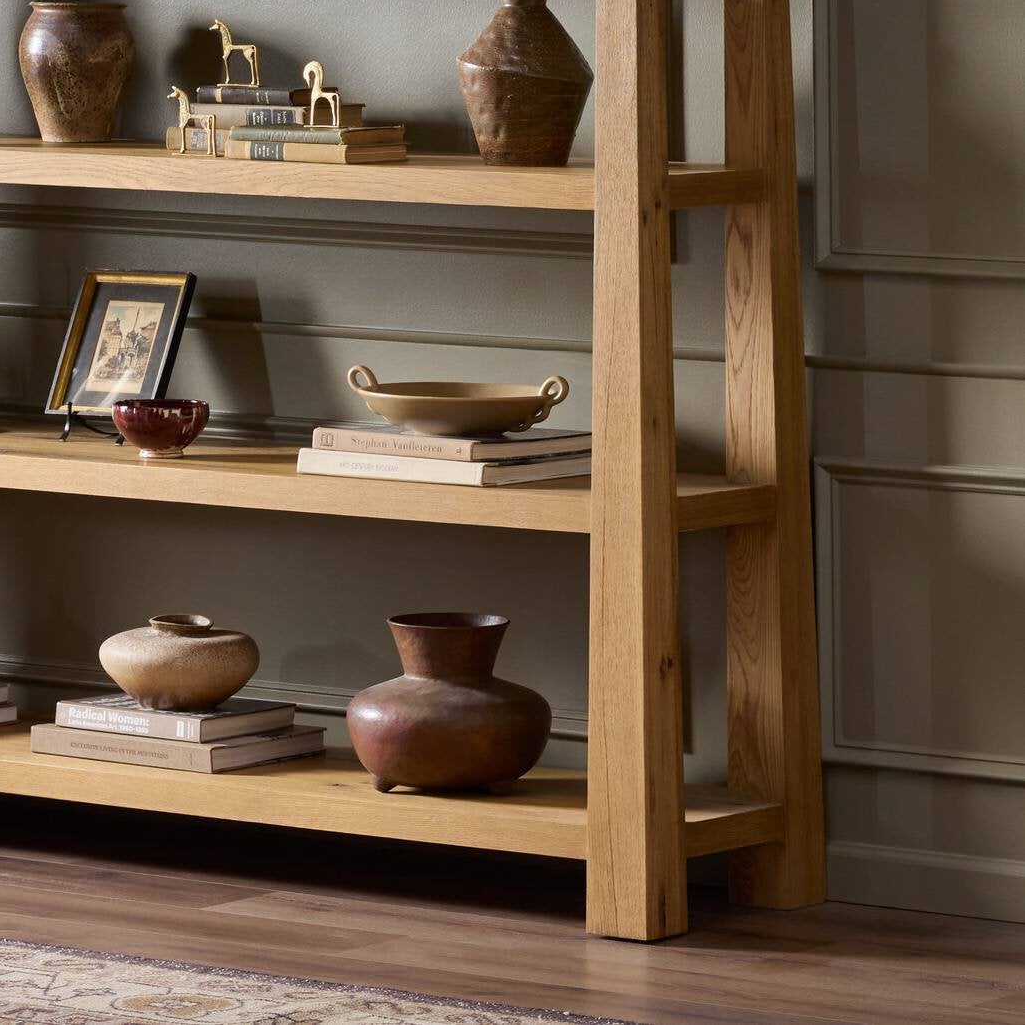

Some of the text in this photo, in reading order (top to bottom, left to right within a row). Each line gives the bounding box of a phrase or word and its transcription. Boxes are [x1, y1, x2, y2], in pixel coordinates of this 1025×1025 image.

[351, 437, 442, 453] Stephan Vanfleteren
[68, 707, 150, 726] Radical Women:
